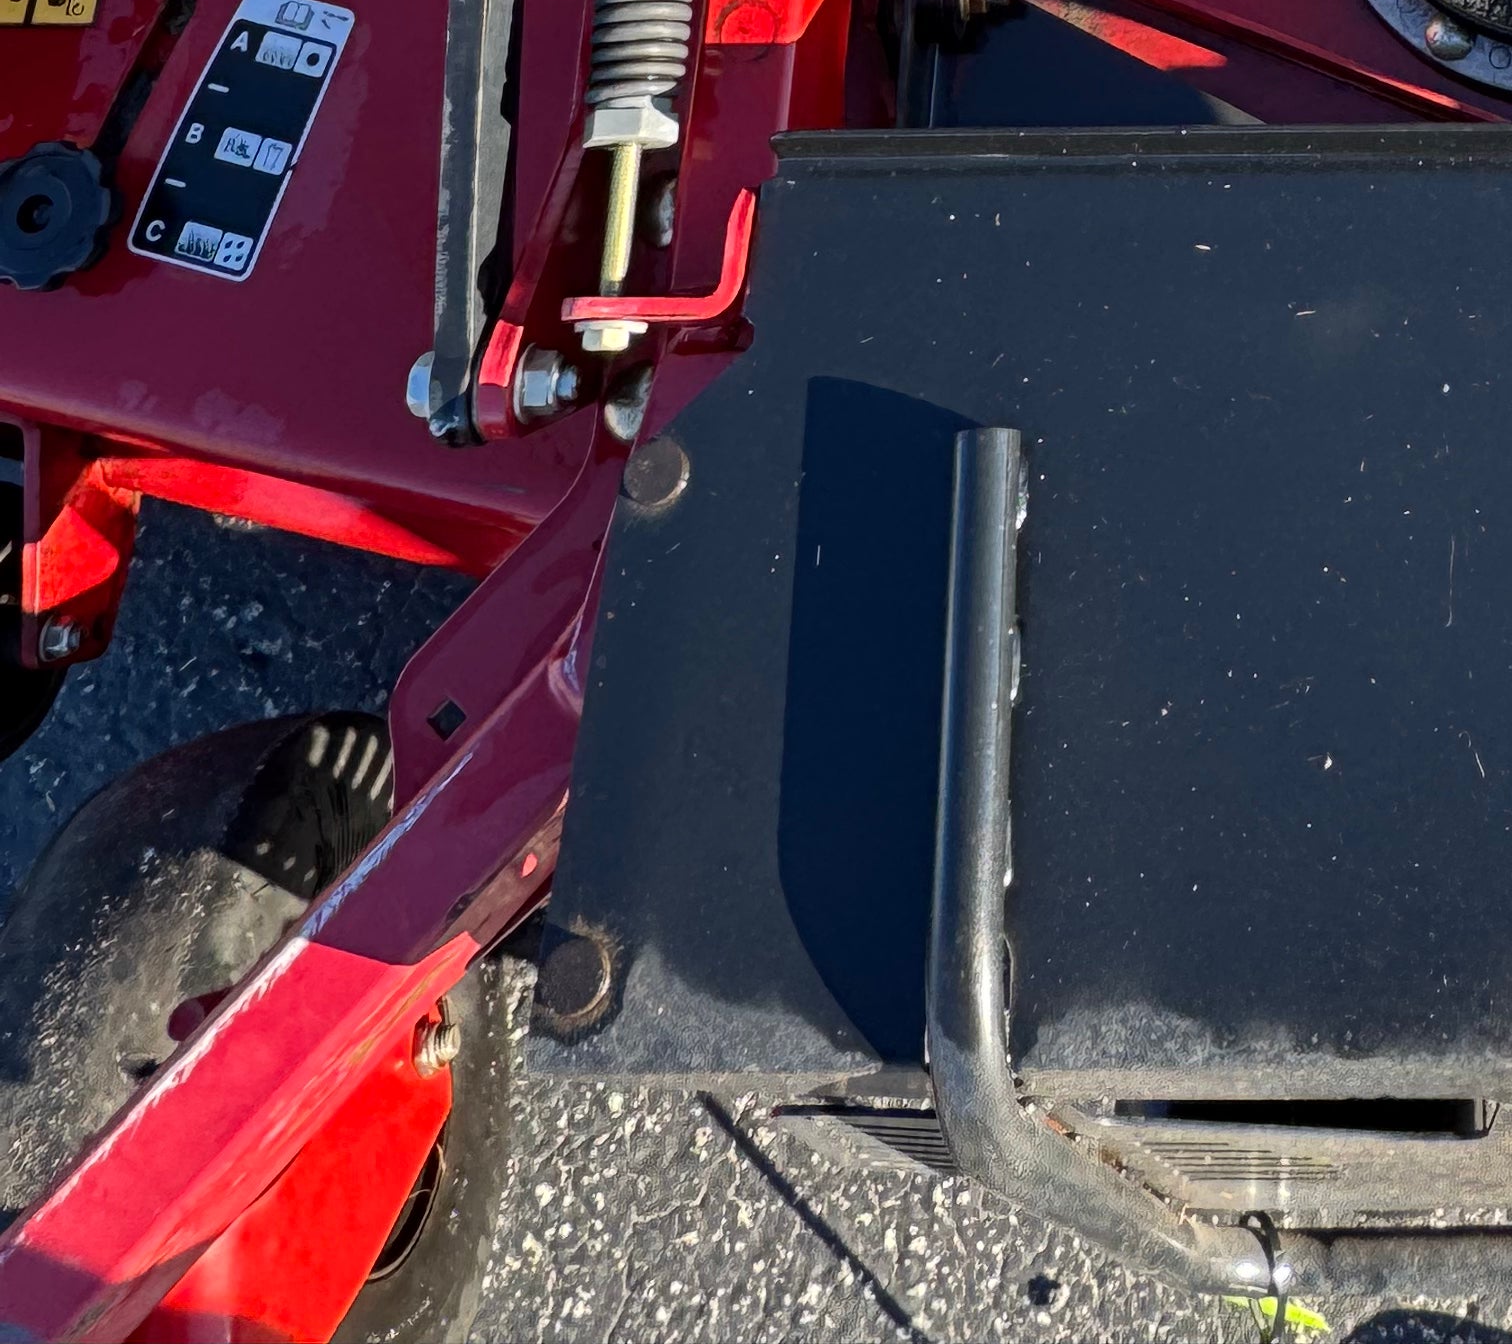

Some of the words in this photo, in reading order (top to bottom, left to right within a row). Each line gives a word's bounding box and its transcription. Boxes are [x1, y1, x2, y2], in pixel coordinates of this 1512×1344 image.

[230, 30, 249, 53] A
[185, 122, 205, 144] B
[145, 219, 166, 242] C
